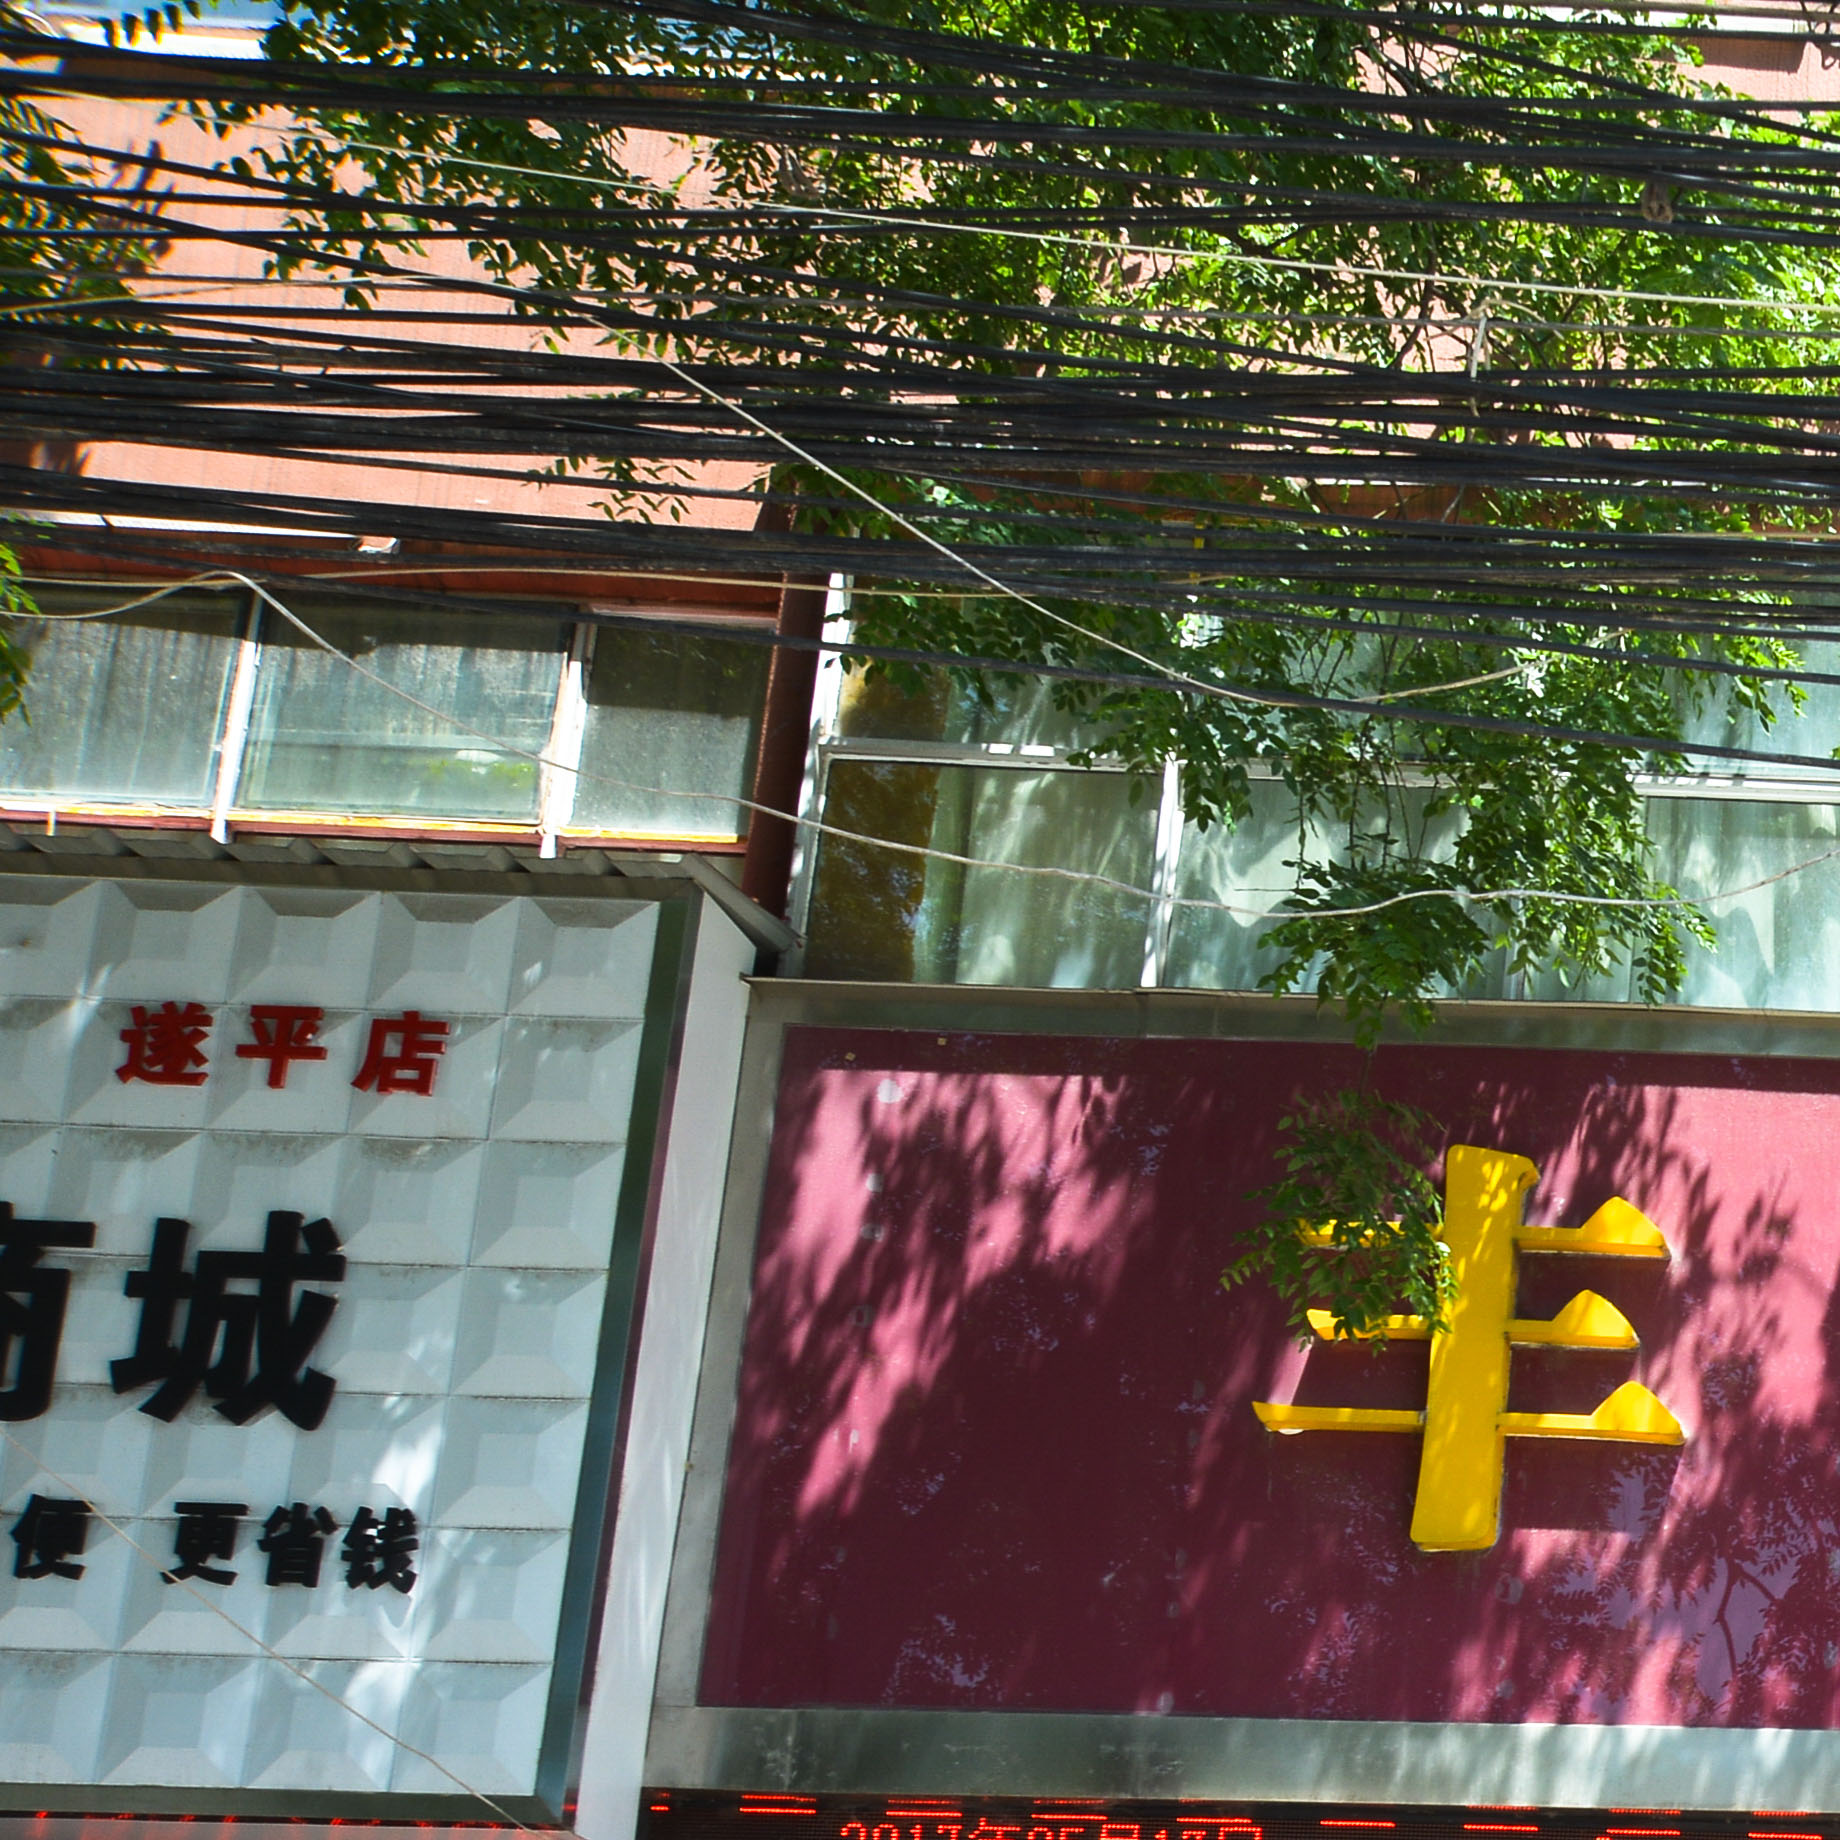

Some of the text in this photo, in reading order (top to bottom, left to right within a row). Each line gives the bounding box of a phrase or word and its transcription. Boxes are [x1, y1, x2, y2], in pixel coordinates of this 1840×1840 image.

[116, 1001, 450, 1096] 遂平店
[12, 1495, 420, 1593] 便 更省钱
